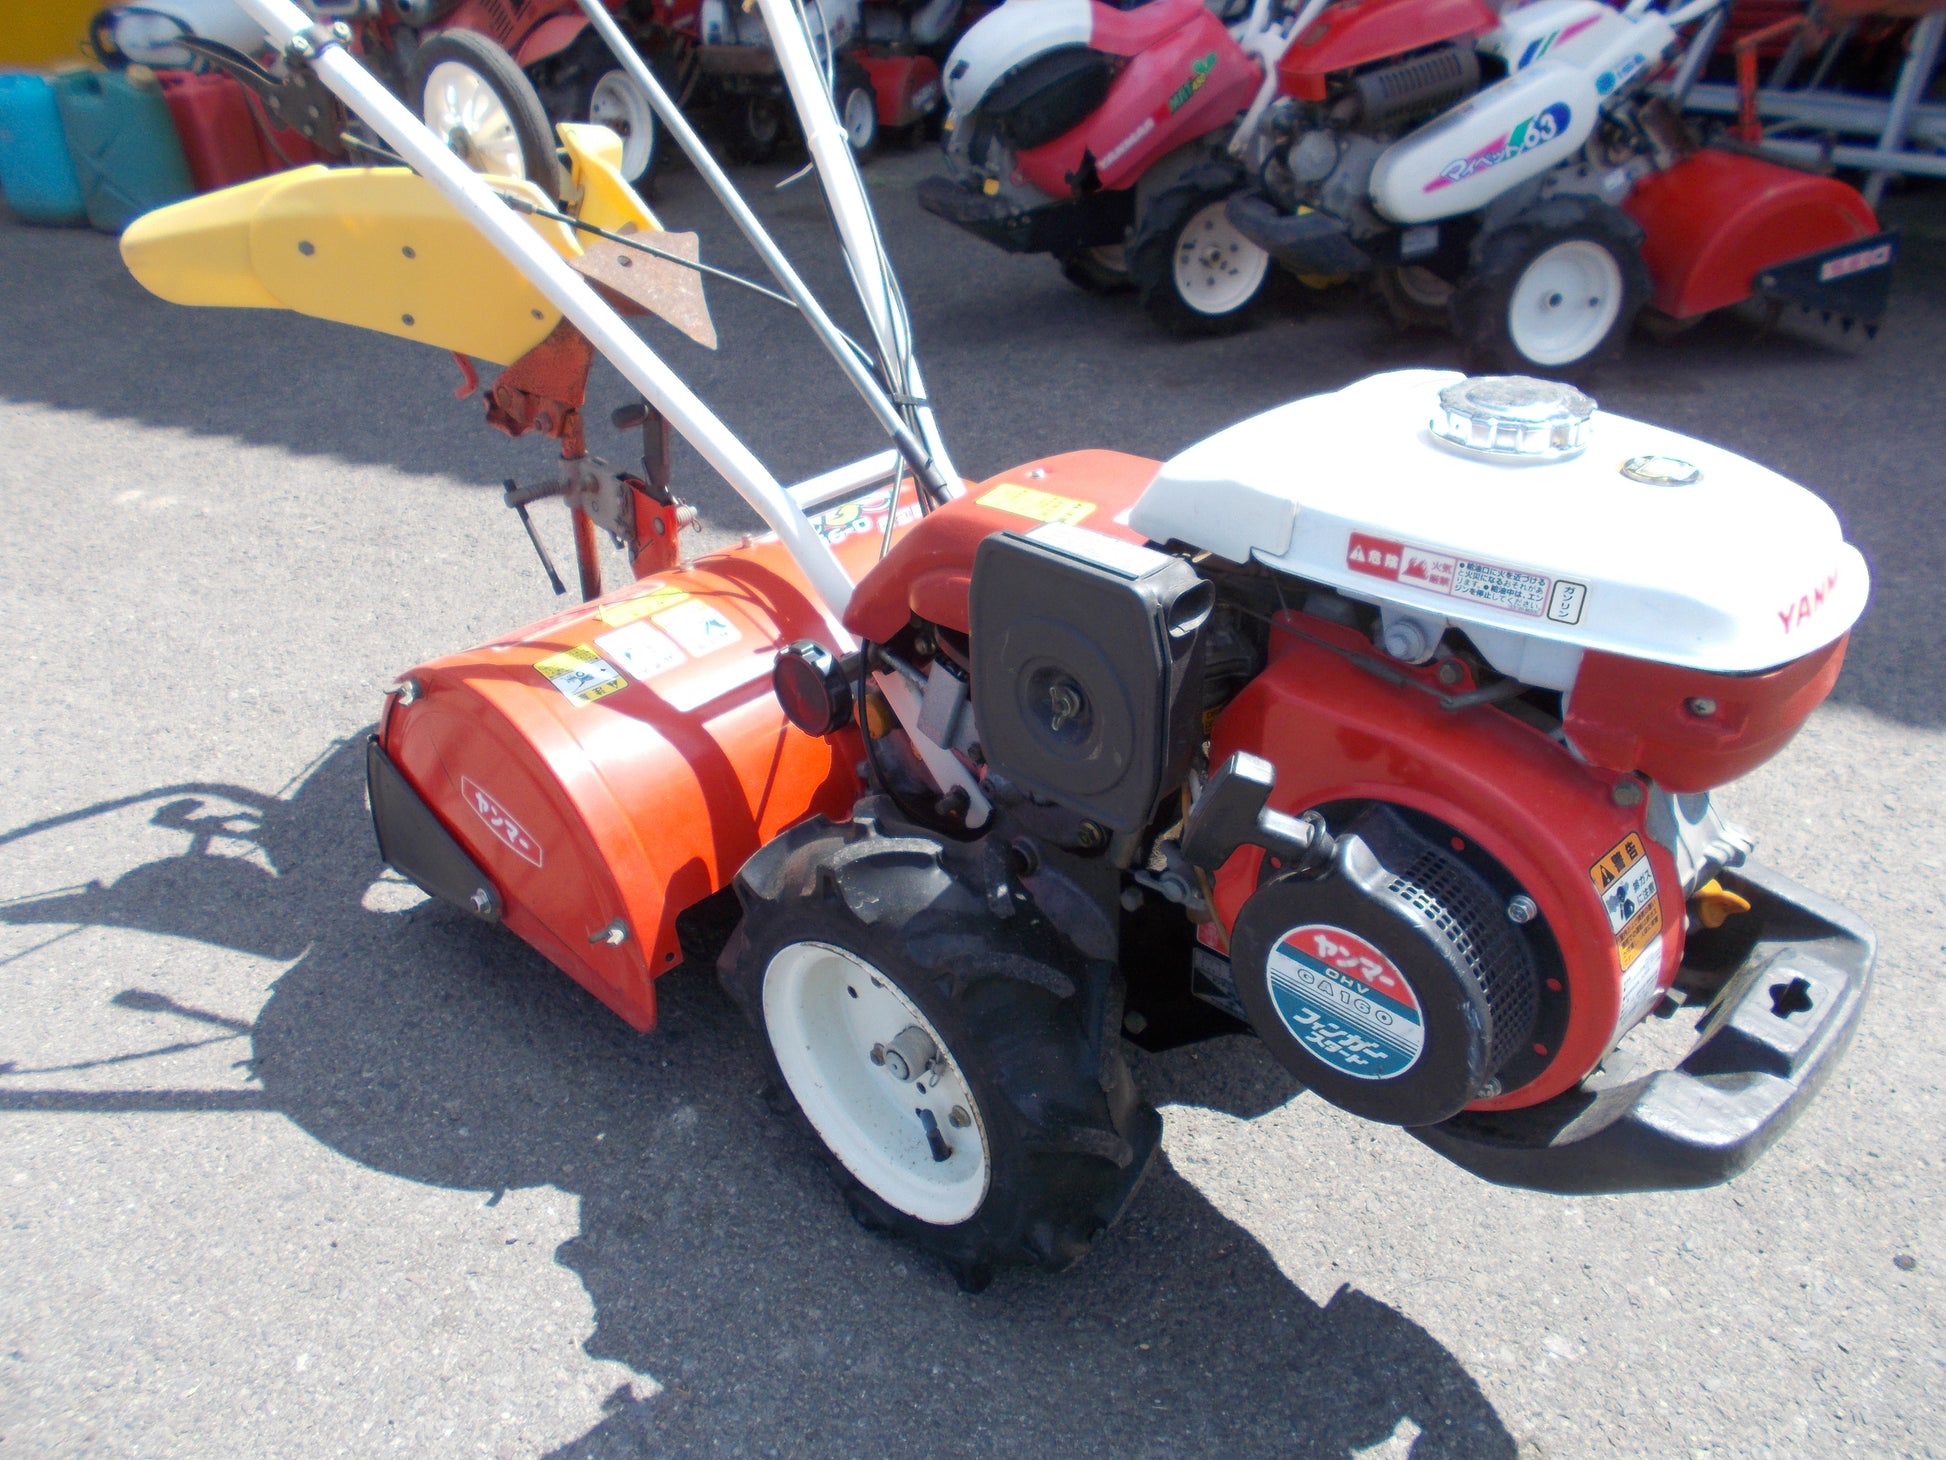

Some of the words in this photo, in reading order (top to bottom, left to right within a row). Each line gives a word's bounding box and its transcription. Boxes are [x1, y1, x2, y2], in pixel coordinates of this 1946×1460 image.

[1367, 548, 1399, 569] 危険
[1431, 560, 1452, 574] 火気
[1559, 585, 1576, 619] ガソリン
[474, 791, 529, 850] ヤンマー
[1610, 840, 1639, 873] 警告
[1312, 933, 1395, 988] ヤンマー
[1296, 967, 1394, 1027] GA160
[1324, 967, 1371, 995] OHV
[1292, 1006, 1389, 1060] フィンガー
[1304, 1032, 1370, 1066] スタート
